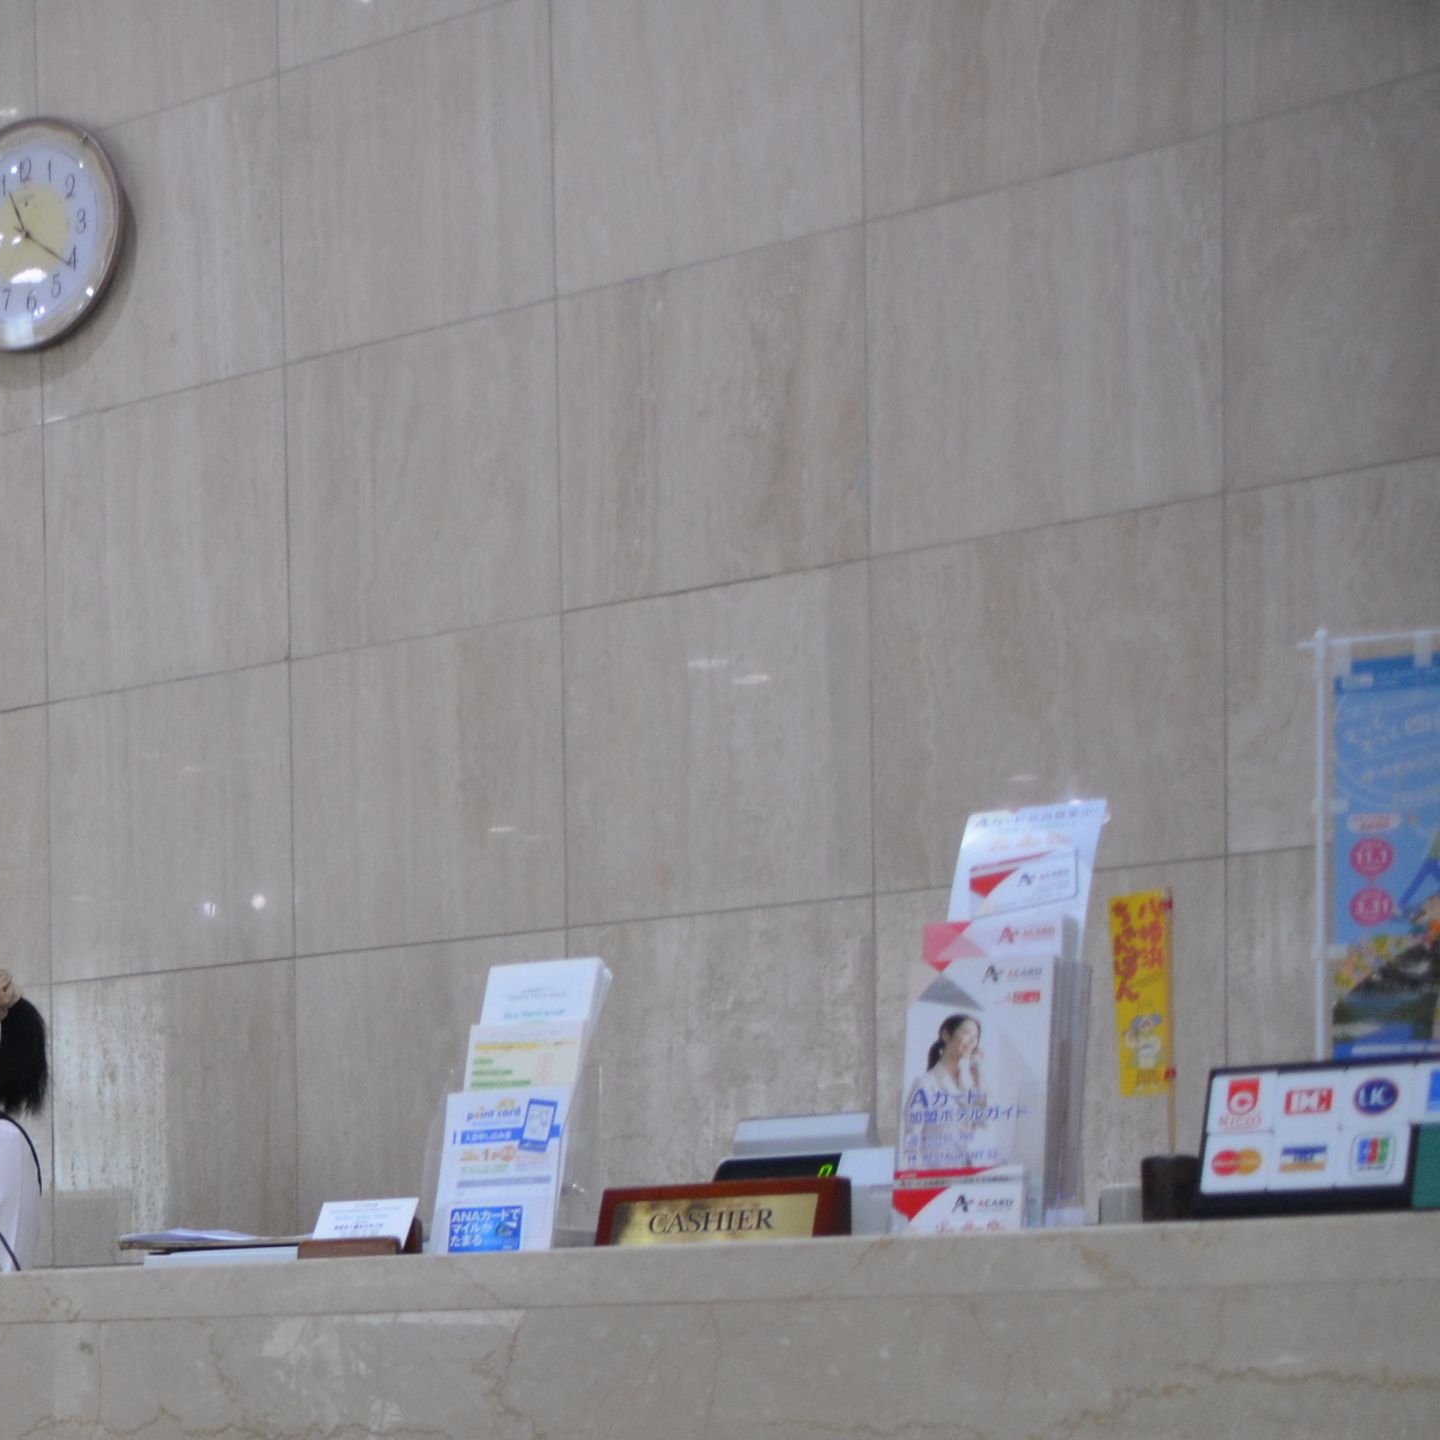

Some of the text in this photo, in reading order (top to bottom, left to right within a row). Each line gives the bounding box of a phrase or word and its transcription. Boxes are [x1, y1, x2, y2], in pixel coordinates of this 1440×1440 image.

[19, 157, 32, 183] 12
[65, 173, 75, 199] 2
[76, 207, 87, 234] 3
[66, 245, 77, 271] 4
[51, 273, 61, 298] 5
[3, 288, 11, 311] 7
[26, 289, 37, 312] 6
[648, 1207, 774, 1234] CASHIER
